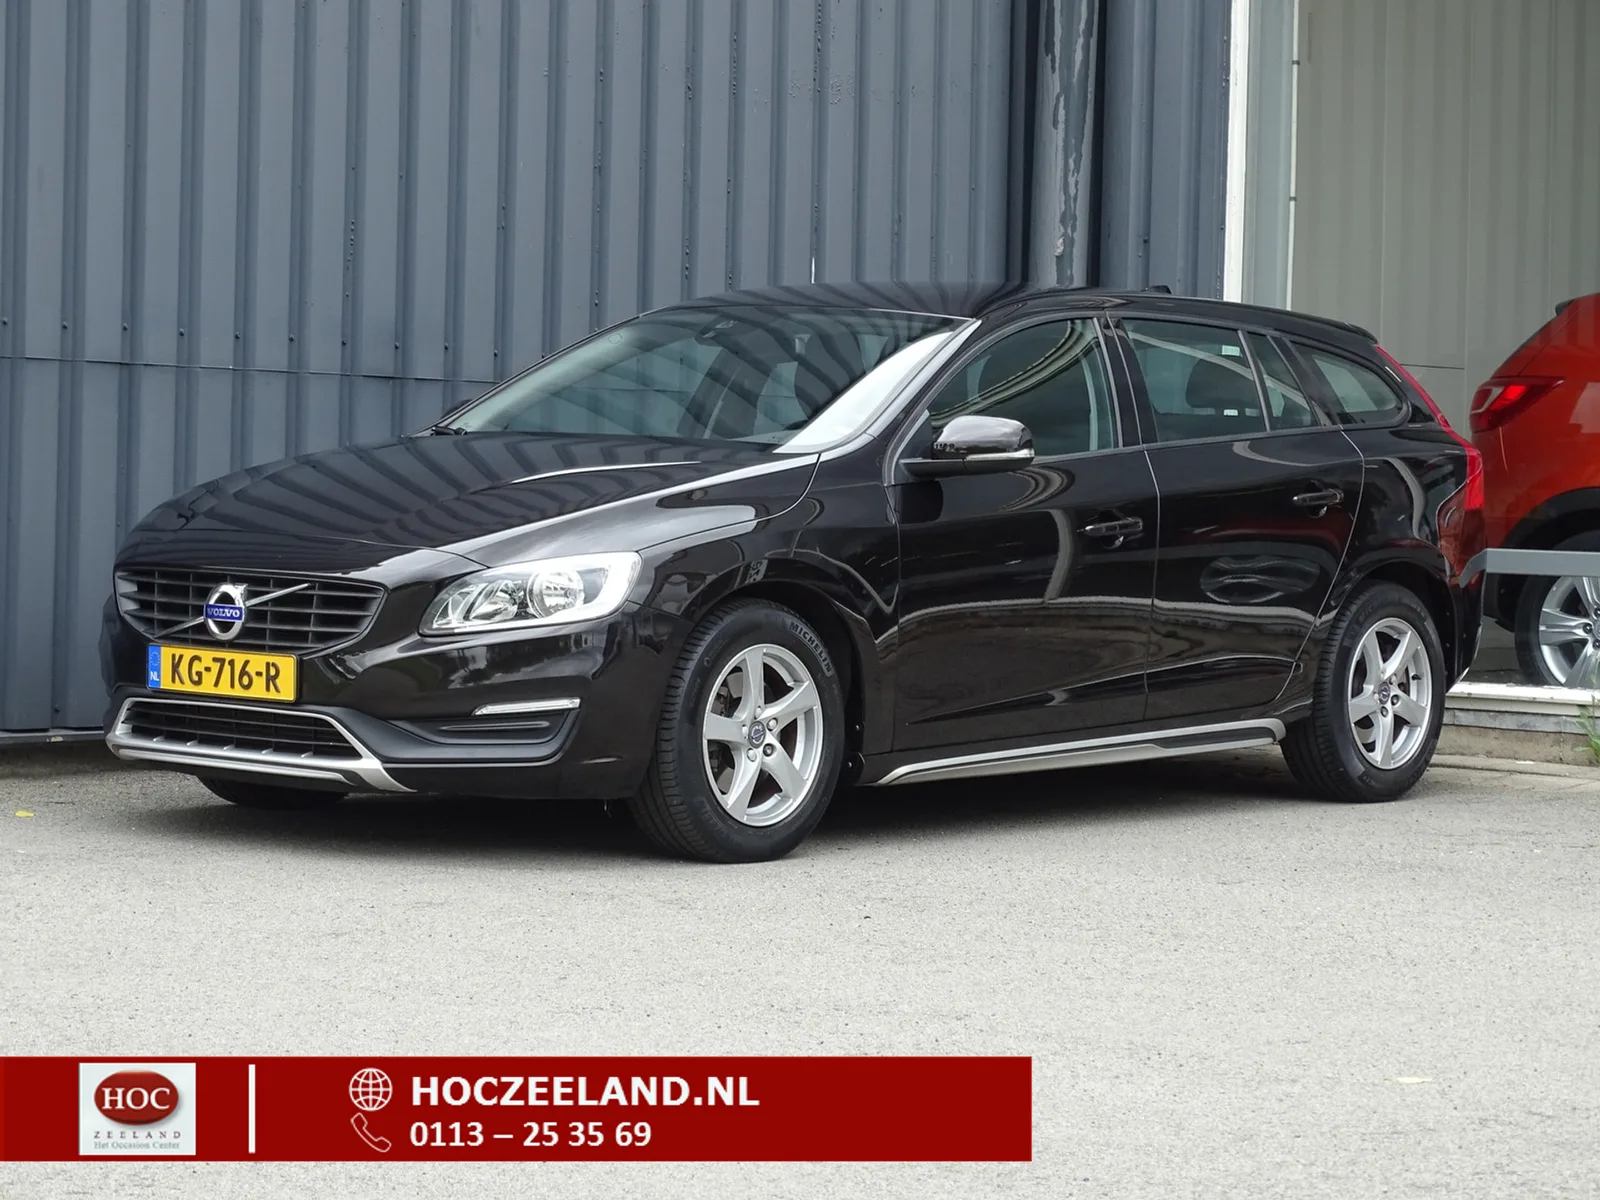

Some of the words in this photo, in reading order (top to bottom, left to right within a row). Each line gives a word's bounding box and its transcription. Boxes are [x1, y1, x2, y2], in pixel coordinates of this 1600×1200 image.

[206, 605, 240, 618] VOLVO
[788, 620, 832, 673] MICHELIN
[150, 671, 160, 682] NL
[171, 653, 281, 693] KG-716-R
